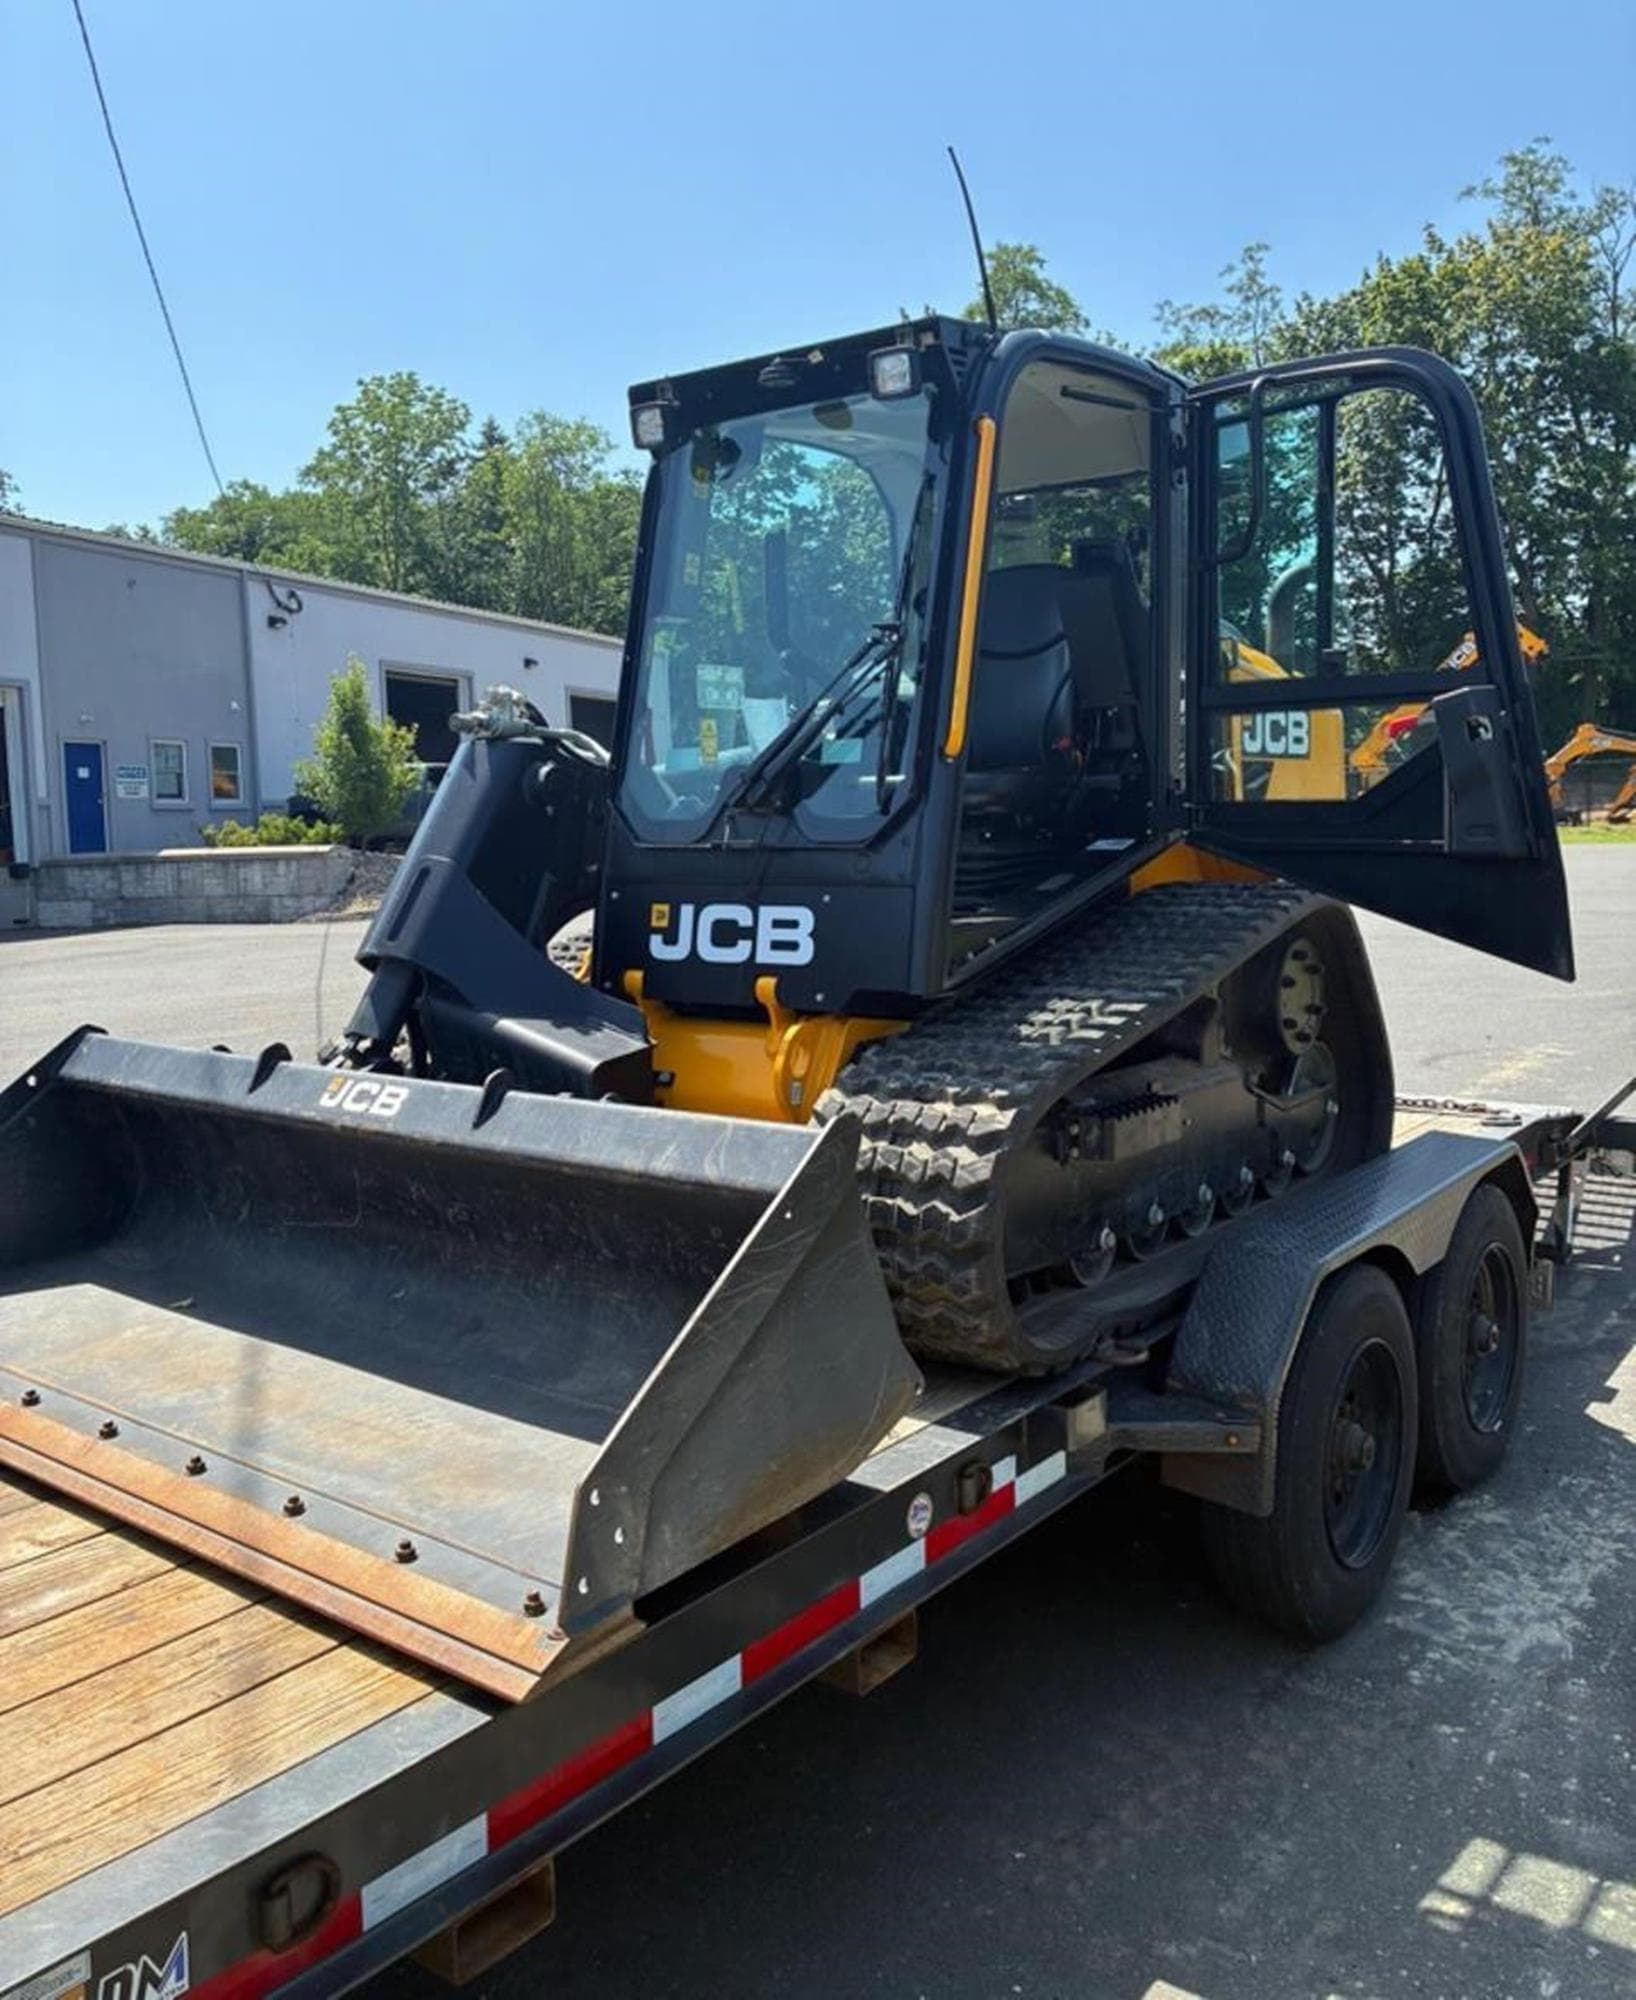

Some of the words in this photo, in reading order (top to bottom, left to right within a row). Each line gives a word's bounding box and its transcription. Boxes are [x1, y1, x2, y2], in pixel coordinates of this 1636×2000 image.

[1242, 711, 1309, 754] JCB
[650, 903, 815, 966] JCB
[320, 1078, 410, 1116] JCB
